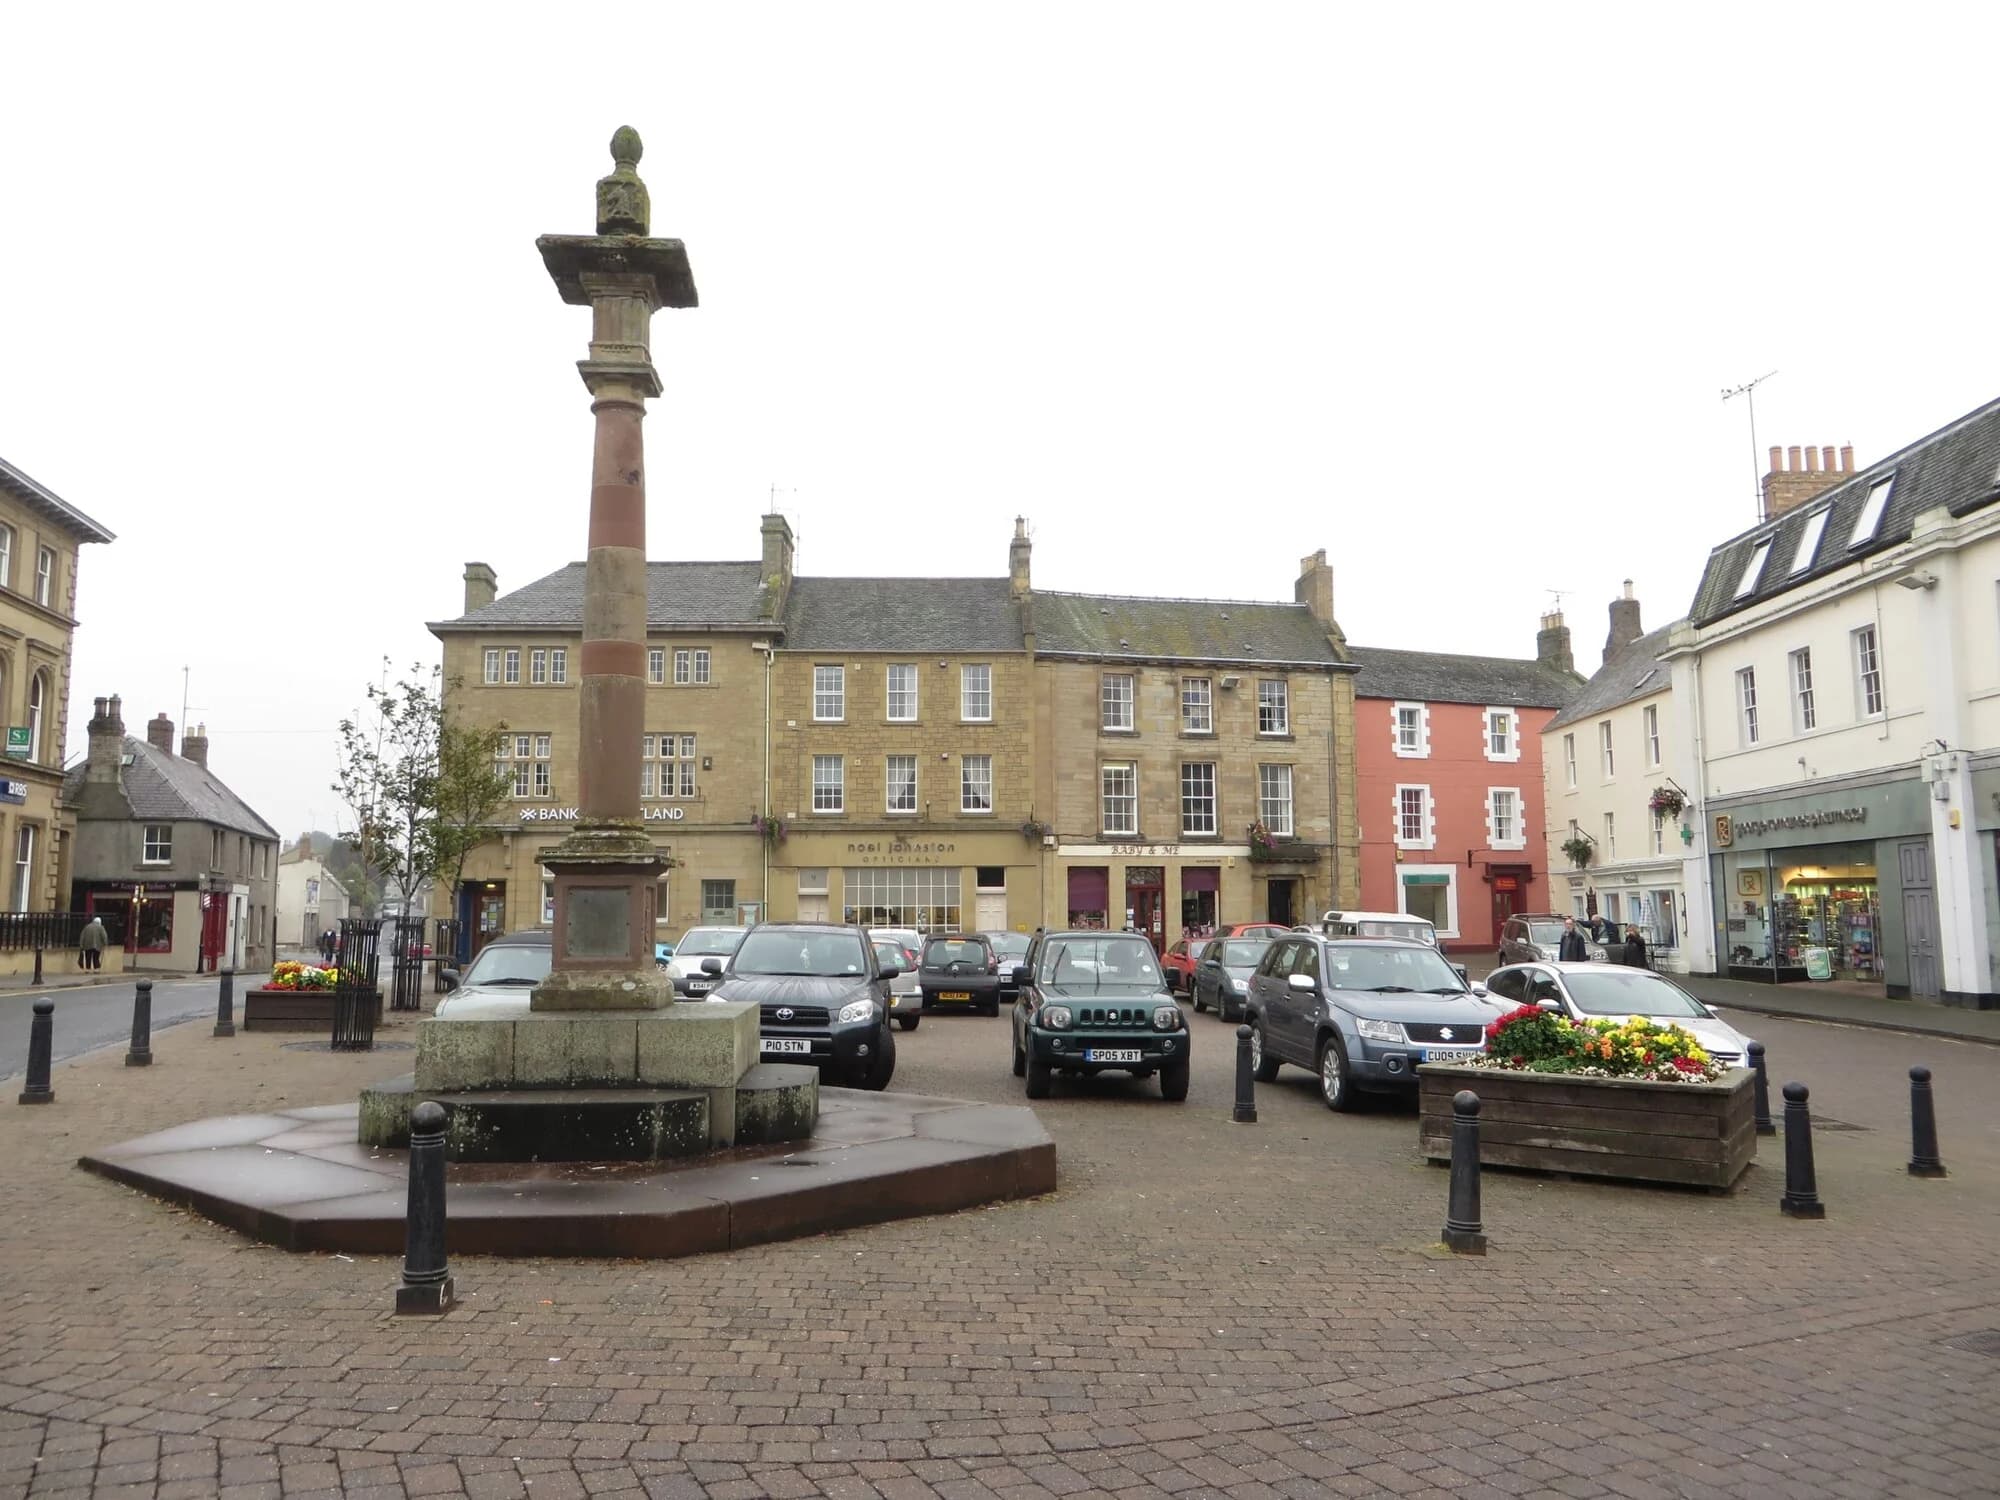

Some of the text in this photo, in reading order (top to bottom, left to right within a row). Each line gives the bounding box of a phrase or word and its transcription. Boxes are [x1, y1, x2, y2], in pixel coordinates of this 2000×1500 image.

[15, 783, 28, 797] RBS
[540, 807, 684, 819] BANK LAND
[848, 842, 955, 854] noel johnston
[1111, 845, 1180, 856] BABY & ME
[784, 1041, 804, 1051] STN
[1092, 1050, 1140, 1060] SP05 XBT
[1428, 1051, 1454, 1061] CU09
